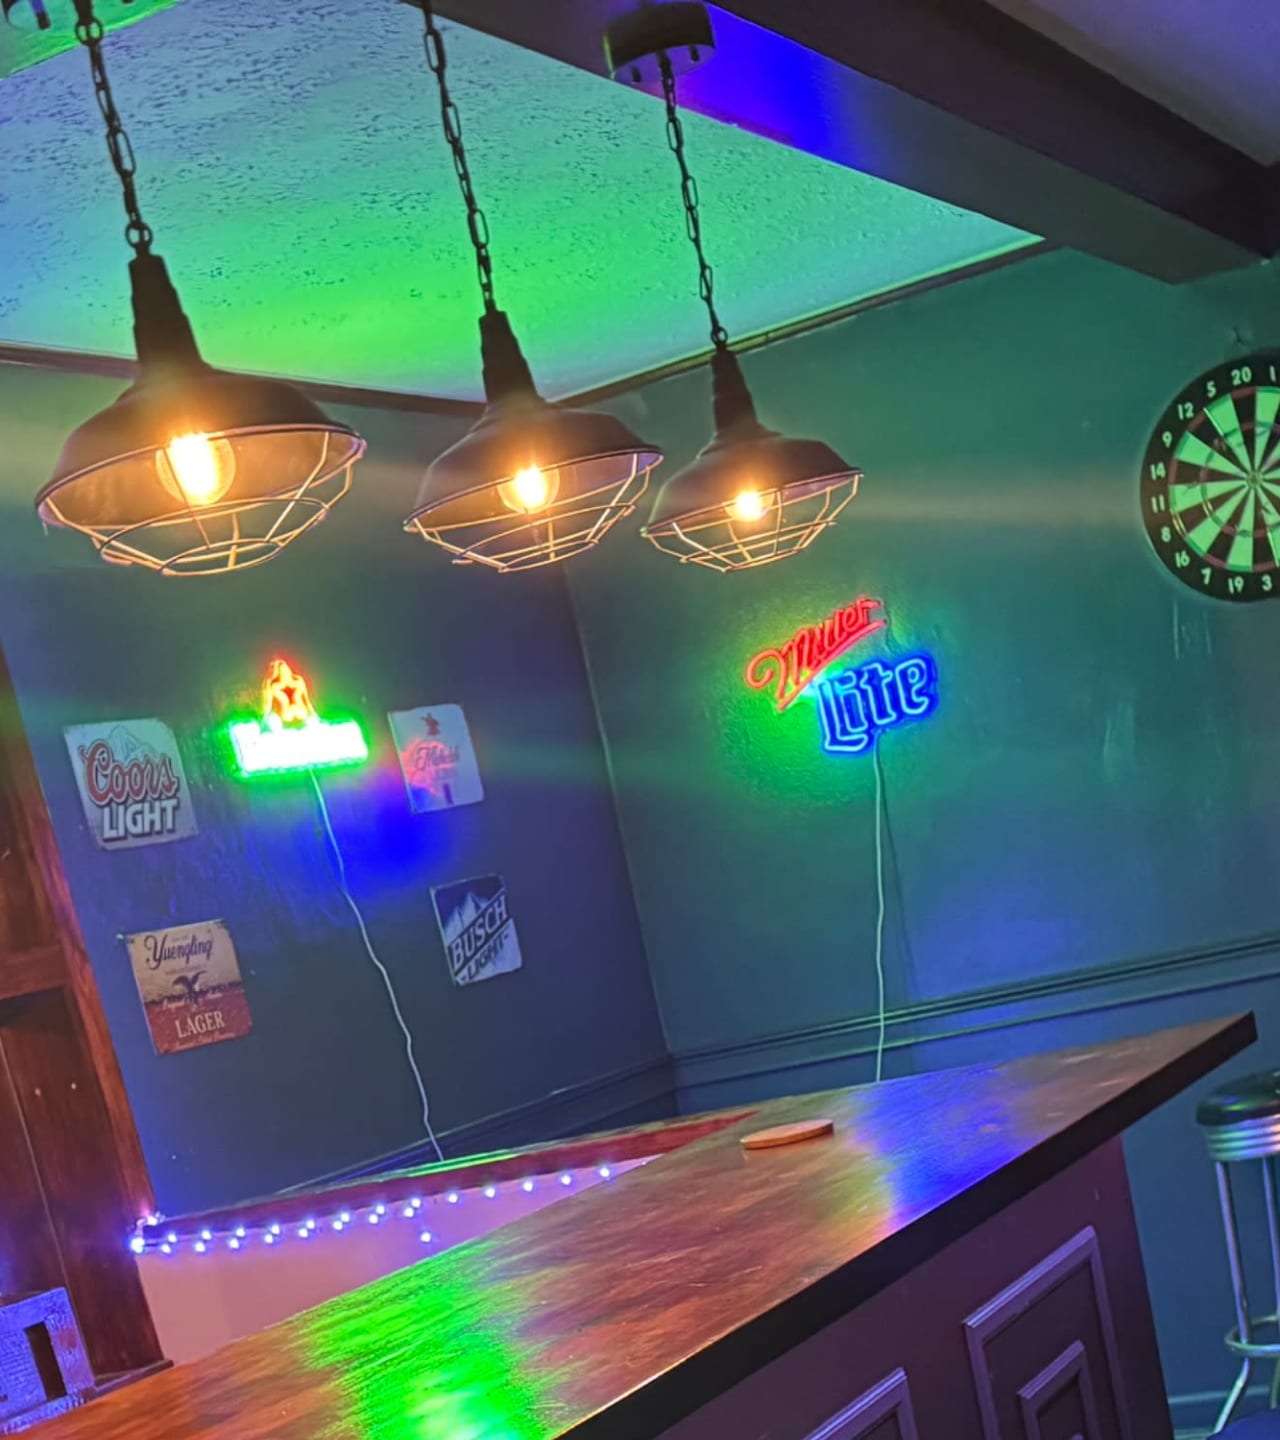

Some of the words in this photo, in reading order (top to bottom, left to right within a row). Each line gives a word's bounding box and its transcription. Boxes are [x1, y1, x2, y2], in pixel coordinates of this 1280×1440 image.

[1231, 367, 1251, 385] 20
[1270, 366, 1276, 381] 1
[1207, 381, 1216, 397] 5
[1178, 402, 1194, 419] 12
[1162, 432, 1172, 447] 9
[1151, 463, 1165, 480] 14
[1152, 495, 1165, 512] 11
[1161, 527, 1171, 542] 8
[1176, 551, 1190, 567] 16
[1201, 568, 1211, 584] 7
[1228, 576, 1244, 593] 19
[1262, 575, 1272, 591] 3
[745, 597, 882, 700] Miller
[817, 657, 931, 752] Lite
[77, 738, 180, 808] Coors
[103, 797, 179, 842] LIGHT
[451, 894, 508, 972] BUSCH
[143, 934, 213, 970] Yuengling
[467, 934, 504, 980] LIGHT
[174, 1010, 226, 1038] LAGER
